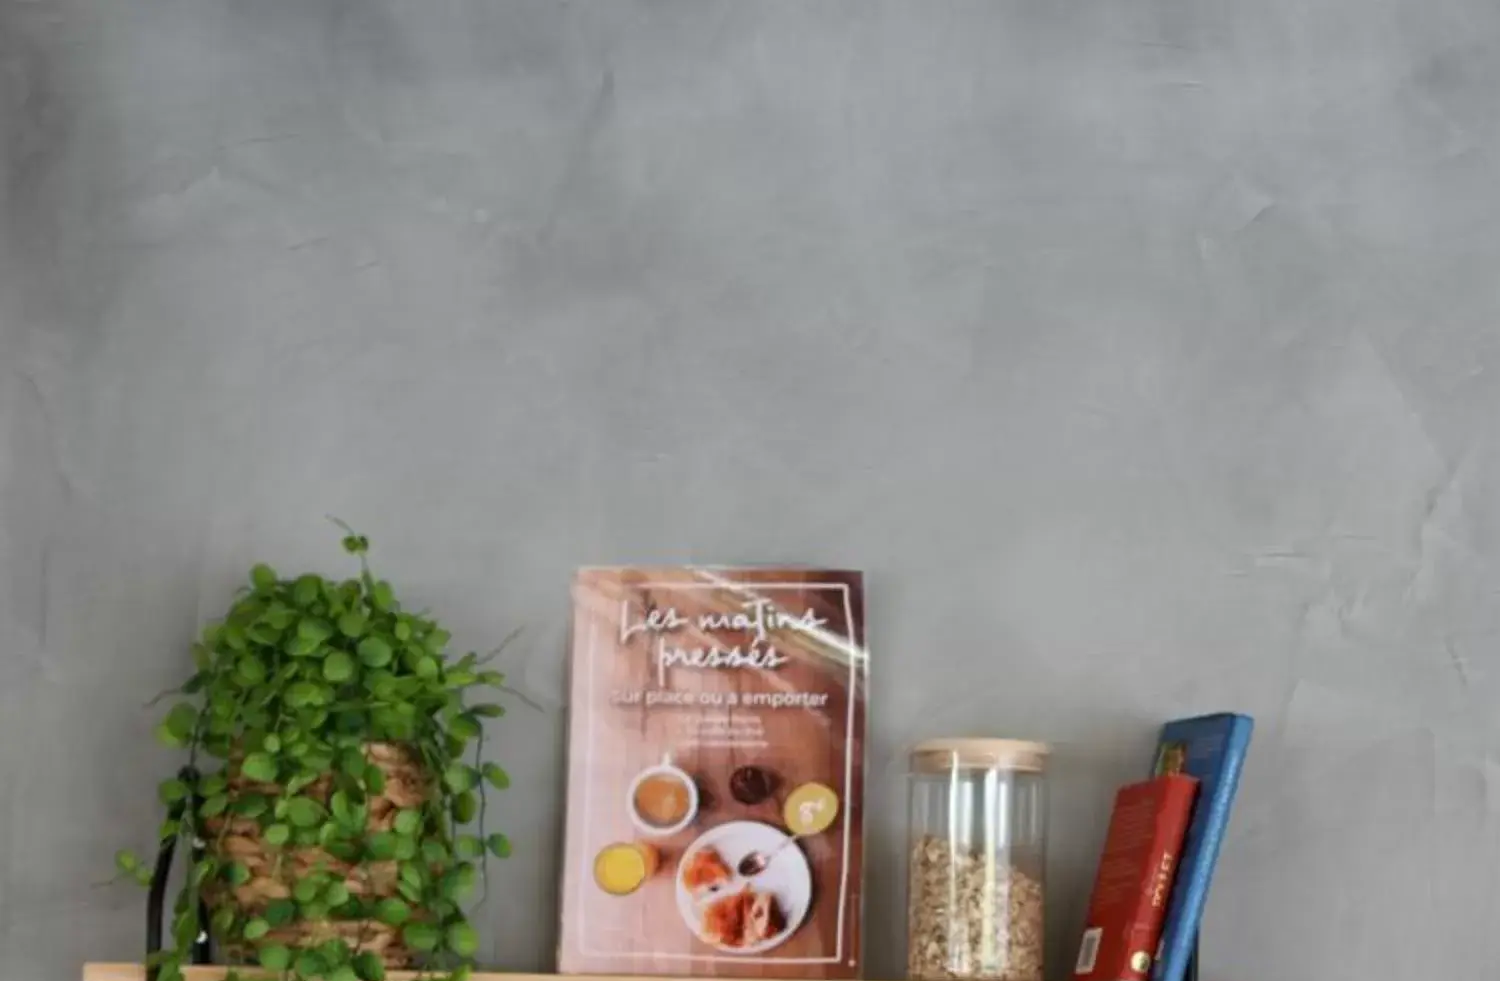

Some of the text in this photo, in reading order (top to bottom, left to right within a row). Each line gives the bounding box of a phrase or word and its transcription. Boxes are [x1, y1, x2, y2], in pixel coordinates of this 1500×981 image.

[621, 598, 829, 644] Les matins
[656, 636, 790, 690] pressés
[699, 690, 724, 705] ou
[742, 690, 829, 710] emporter
